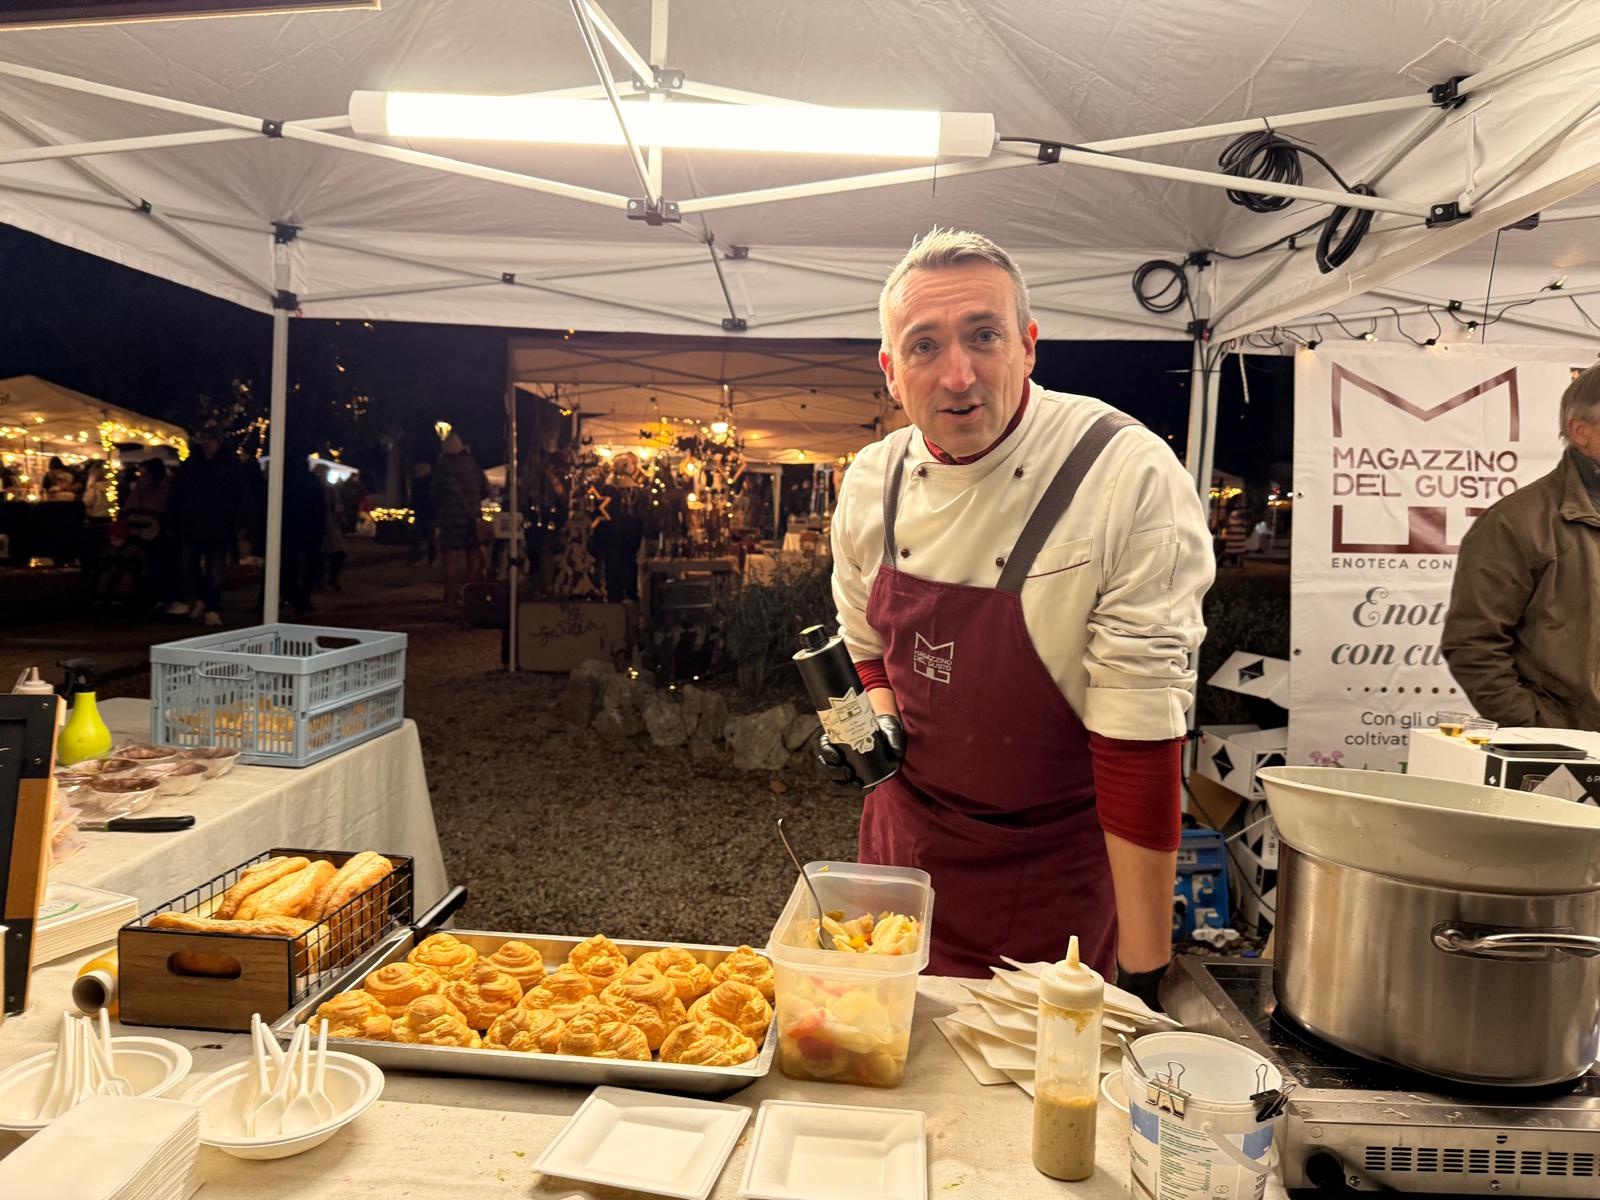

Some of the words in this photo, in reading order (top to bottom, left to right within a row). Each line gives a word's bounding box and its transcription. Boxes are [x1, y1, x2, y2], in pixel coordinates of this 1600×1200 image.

[1333, 446, 1518, 473] MAGAZZINO
[1333, 473, 1402, 497] DEL
[1415, 474, 1518, 499] GUSTO
[1331, 558, 1409, 569] ENOTECA
[1418, 559, 1453, 570] CON
[1331, 643, 1395, 665] con
[1361, 711, 1395, 726] Con
[1400, 711, 1421, 729] gli
